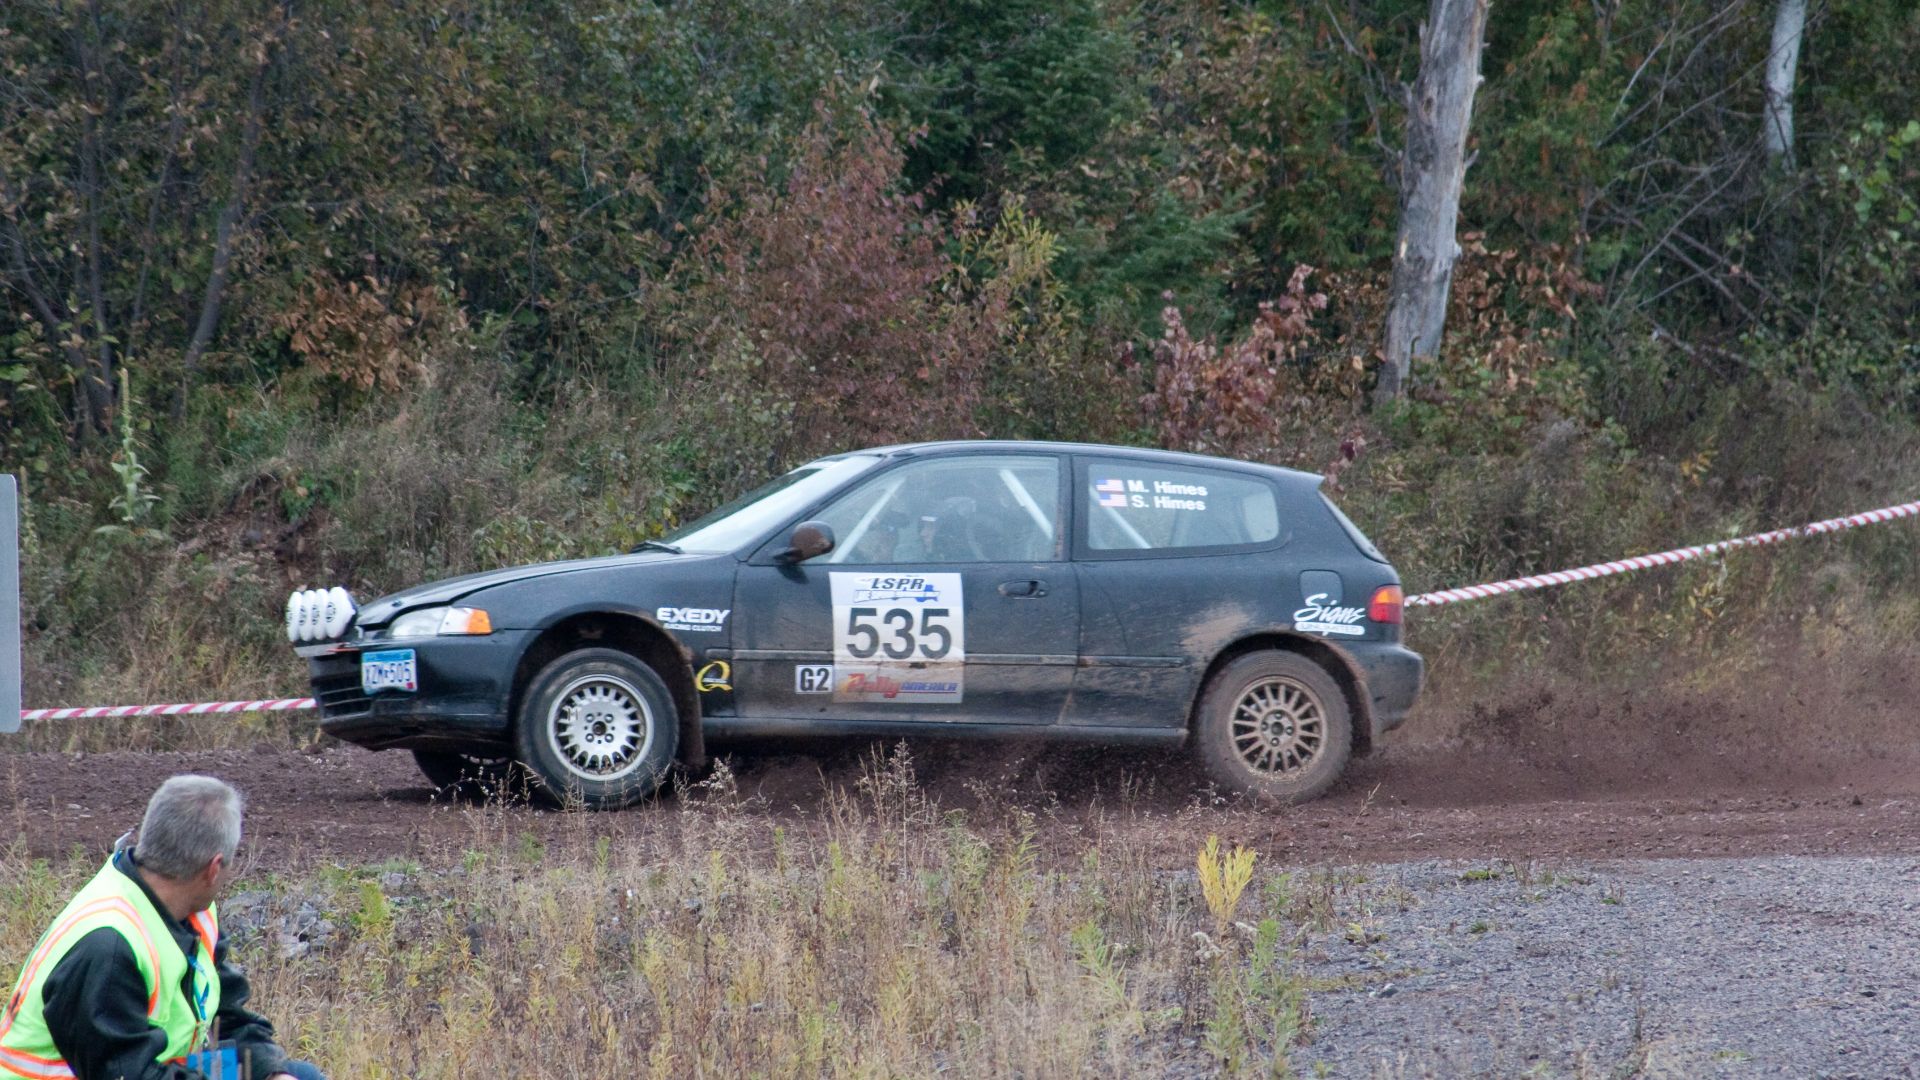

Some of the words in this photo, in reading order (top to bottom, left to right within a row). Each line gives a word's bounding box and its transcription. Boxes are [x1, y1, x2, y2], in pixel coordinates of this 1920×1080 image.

[1127, 479, 1149, 493] M.
[1153, 481, 1208, 496] Himes
[1131, 495, 1149, 508] S.
[1153, 496, 1206, 511] Himes
[871, 577, 925, 590] LSPR
[656, 607, 731, 624] EXEDY
[1293, 593, 1366, 636] Signs
[845, 607, 952, 660] 535
[800, 667, 830, 692] G2
